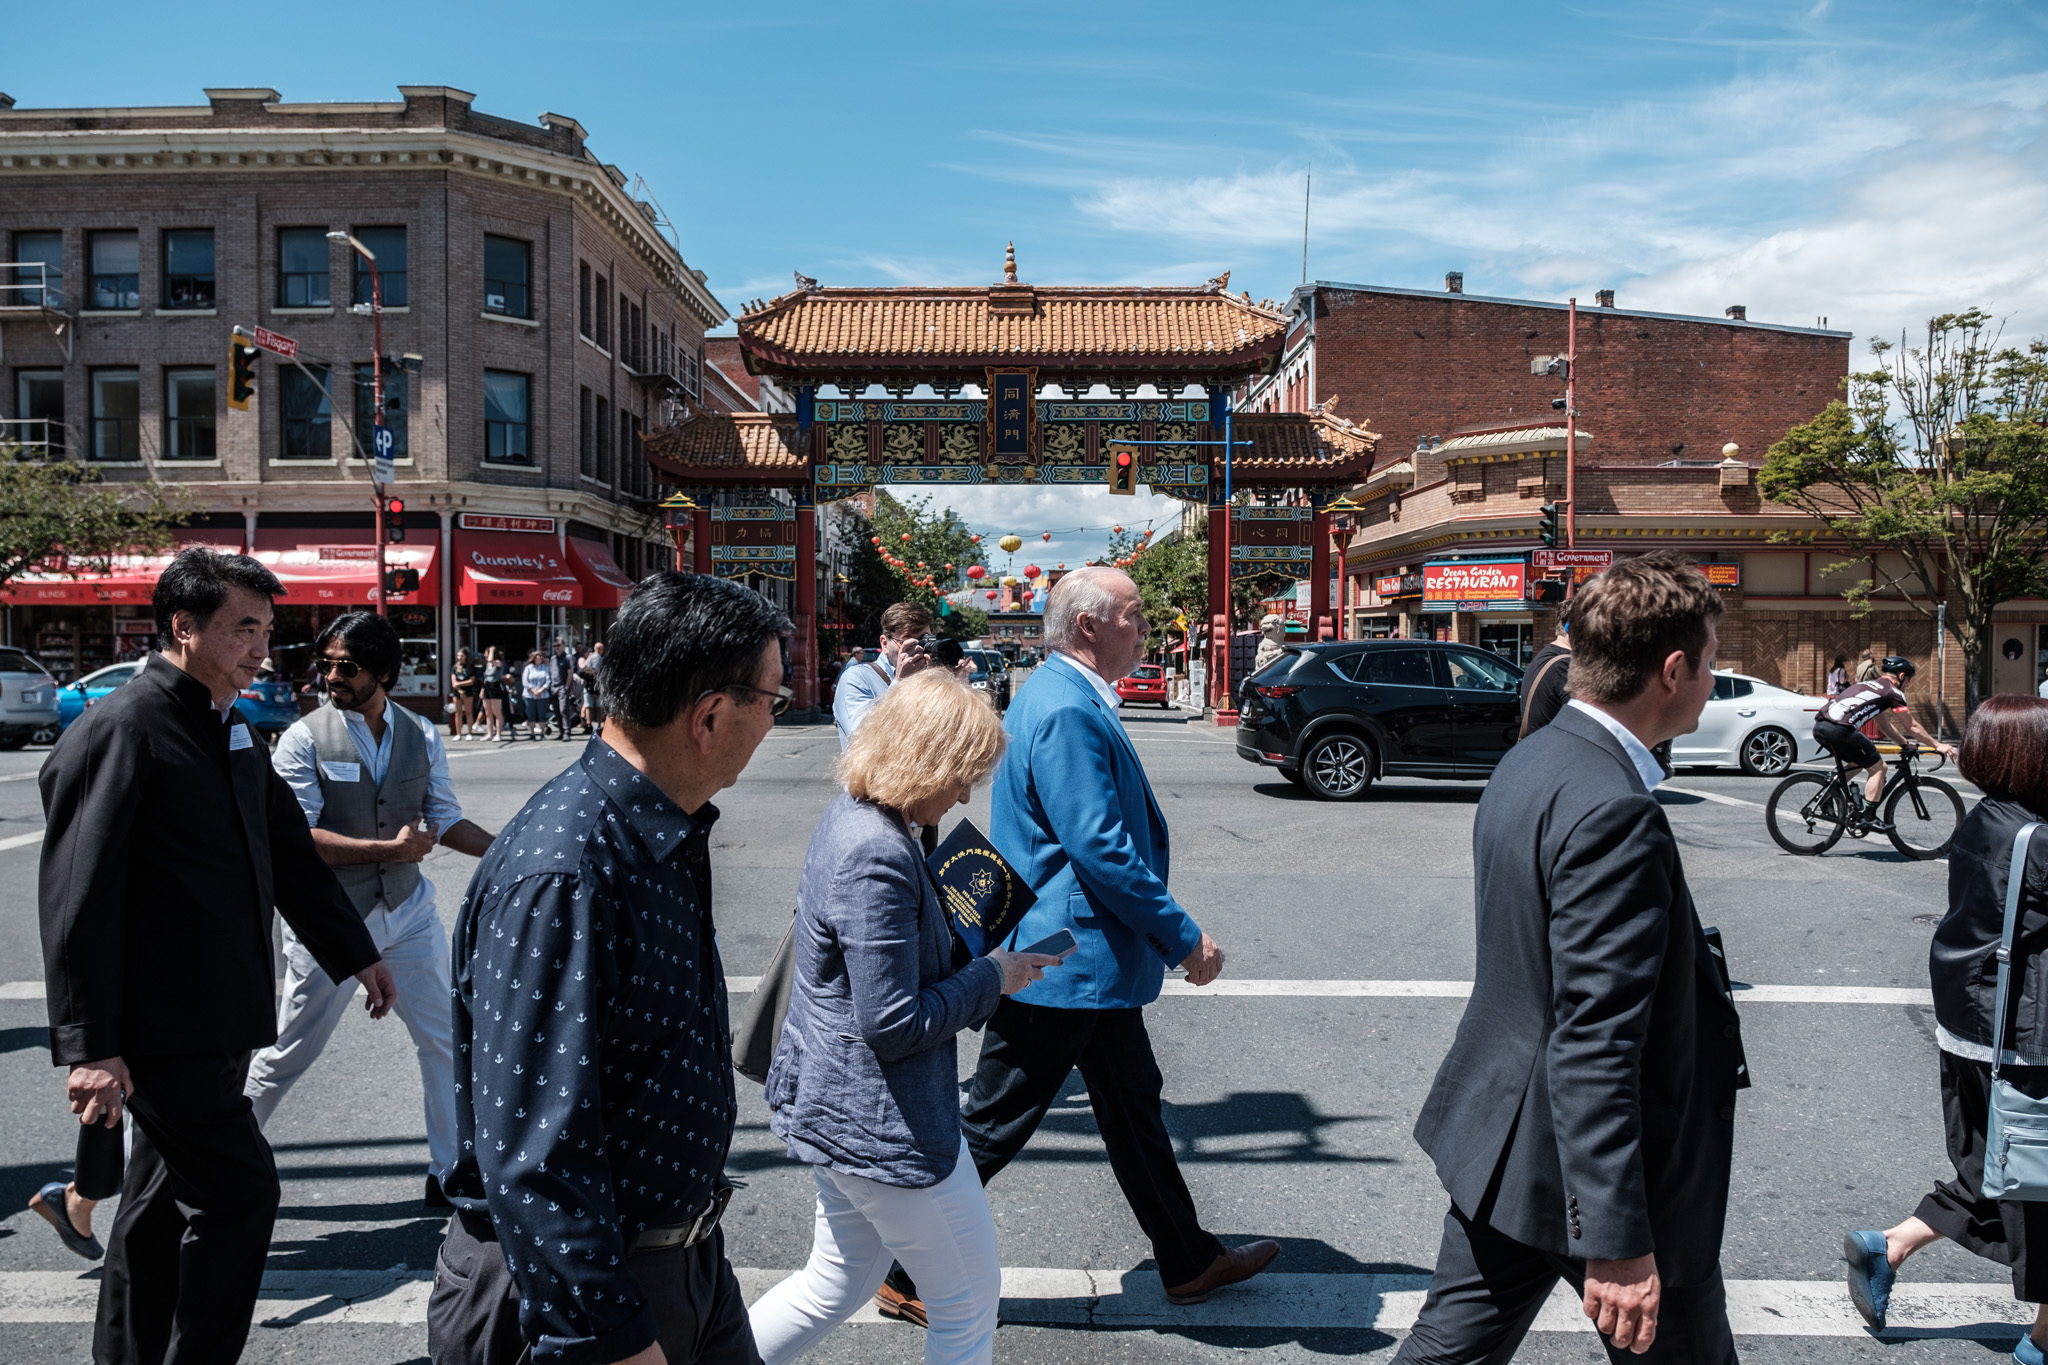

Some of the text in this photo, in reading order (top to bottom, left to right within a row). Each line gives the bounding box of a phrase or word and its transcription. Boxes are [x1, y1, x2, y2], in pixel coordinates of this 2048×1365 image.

[266, 332, 297, 354] Fisgard
[1003, 388, 1021, 440] 同濟門
[382, 430, 393, 457] P
[1556, 552, 1609, 562] Government
[1443, 566, 1502, 577] Ocean Garden
[1426, 575, 1519, 590] RESTAURANT
[38, 590, 66, 598] BLINDS
[1458, 602, 1487, 611] OPEN
